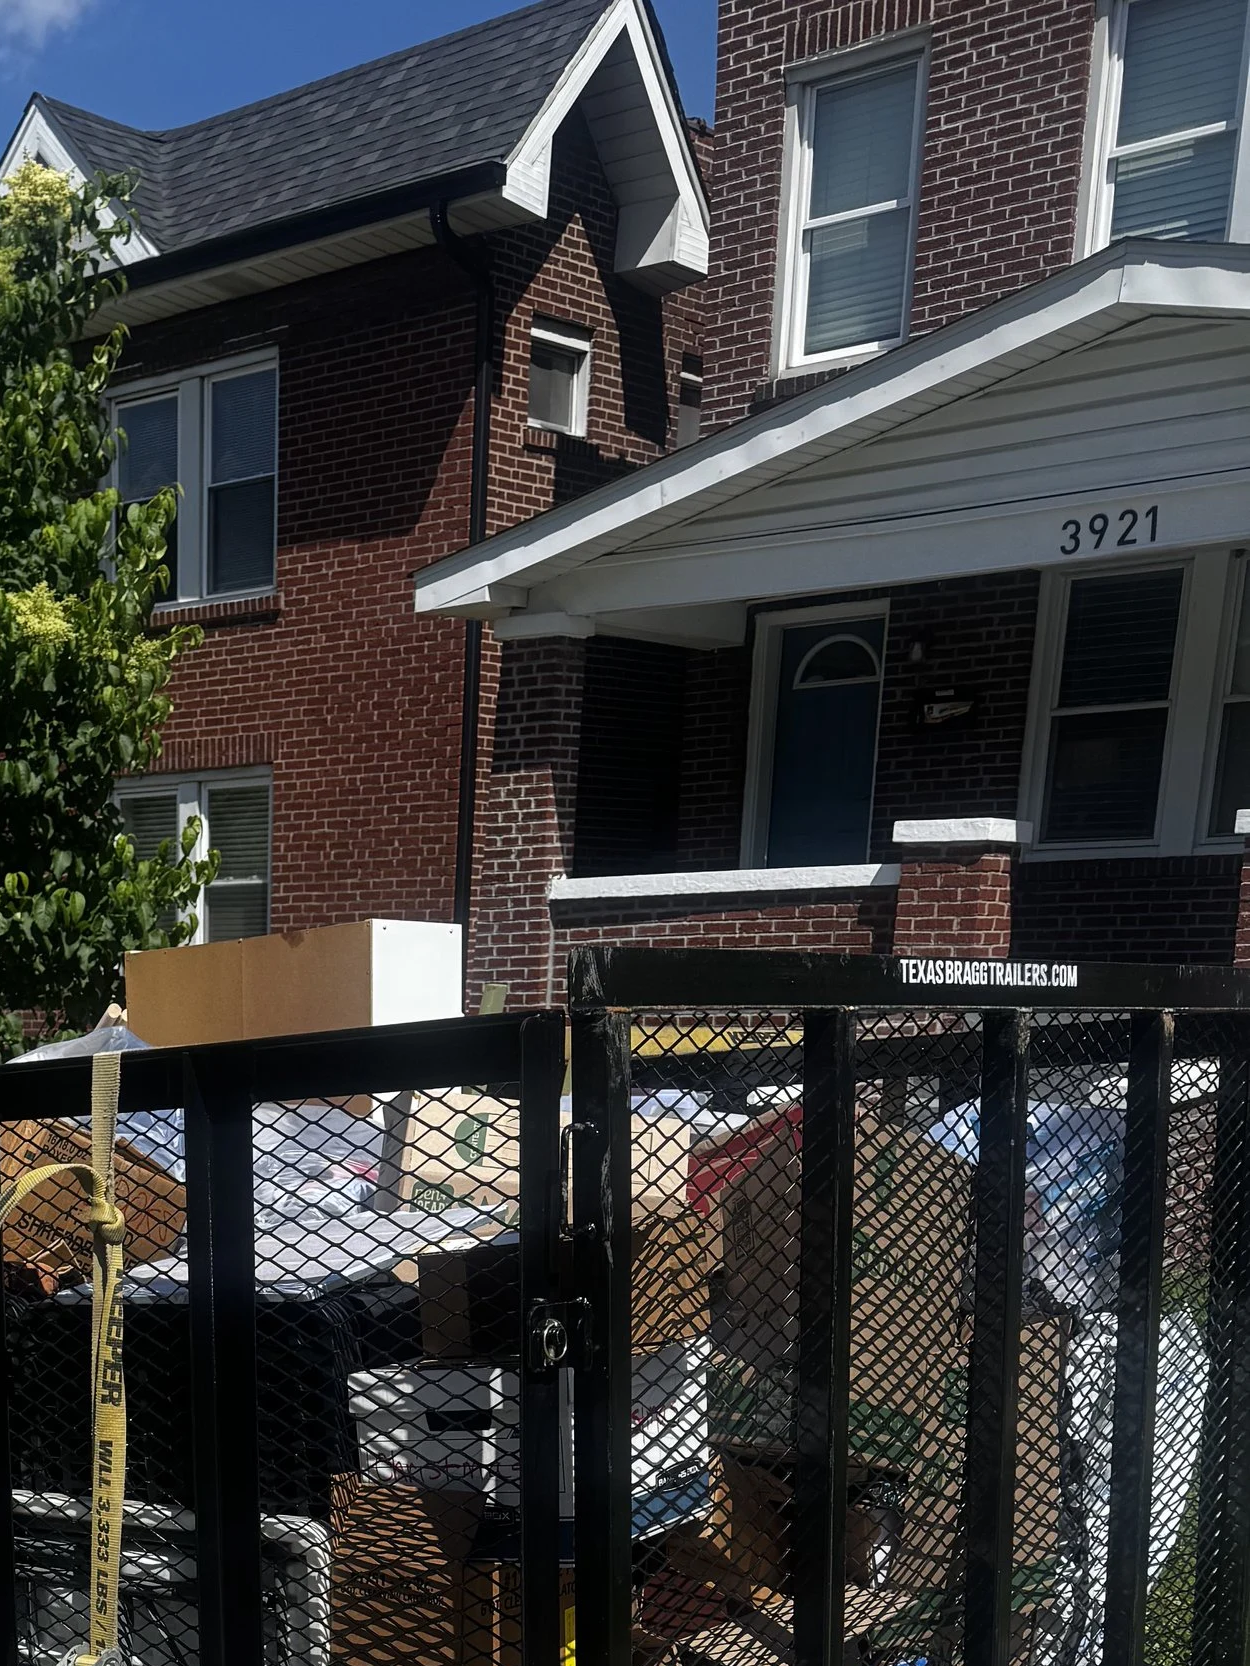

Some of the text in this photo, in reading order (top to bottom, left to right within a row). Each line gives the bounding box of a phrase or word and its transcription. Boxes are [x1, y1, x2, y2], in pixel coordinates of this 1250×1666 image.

[1060, 505, 1158, 555] 3921
[899, 958, 1078, 988] TEXASBRAGGTRAILERS.COM
[98, 1439, 113, 1488] WLL
[95, 1495, 111, 1563] 3,333
[94, 1568, 109, 1616] LBS
